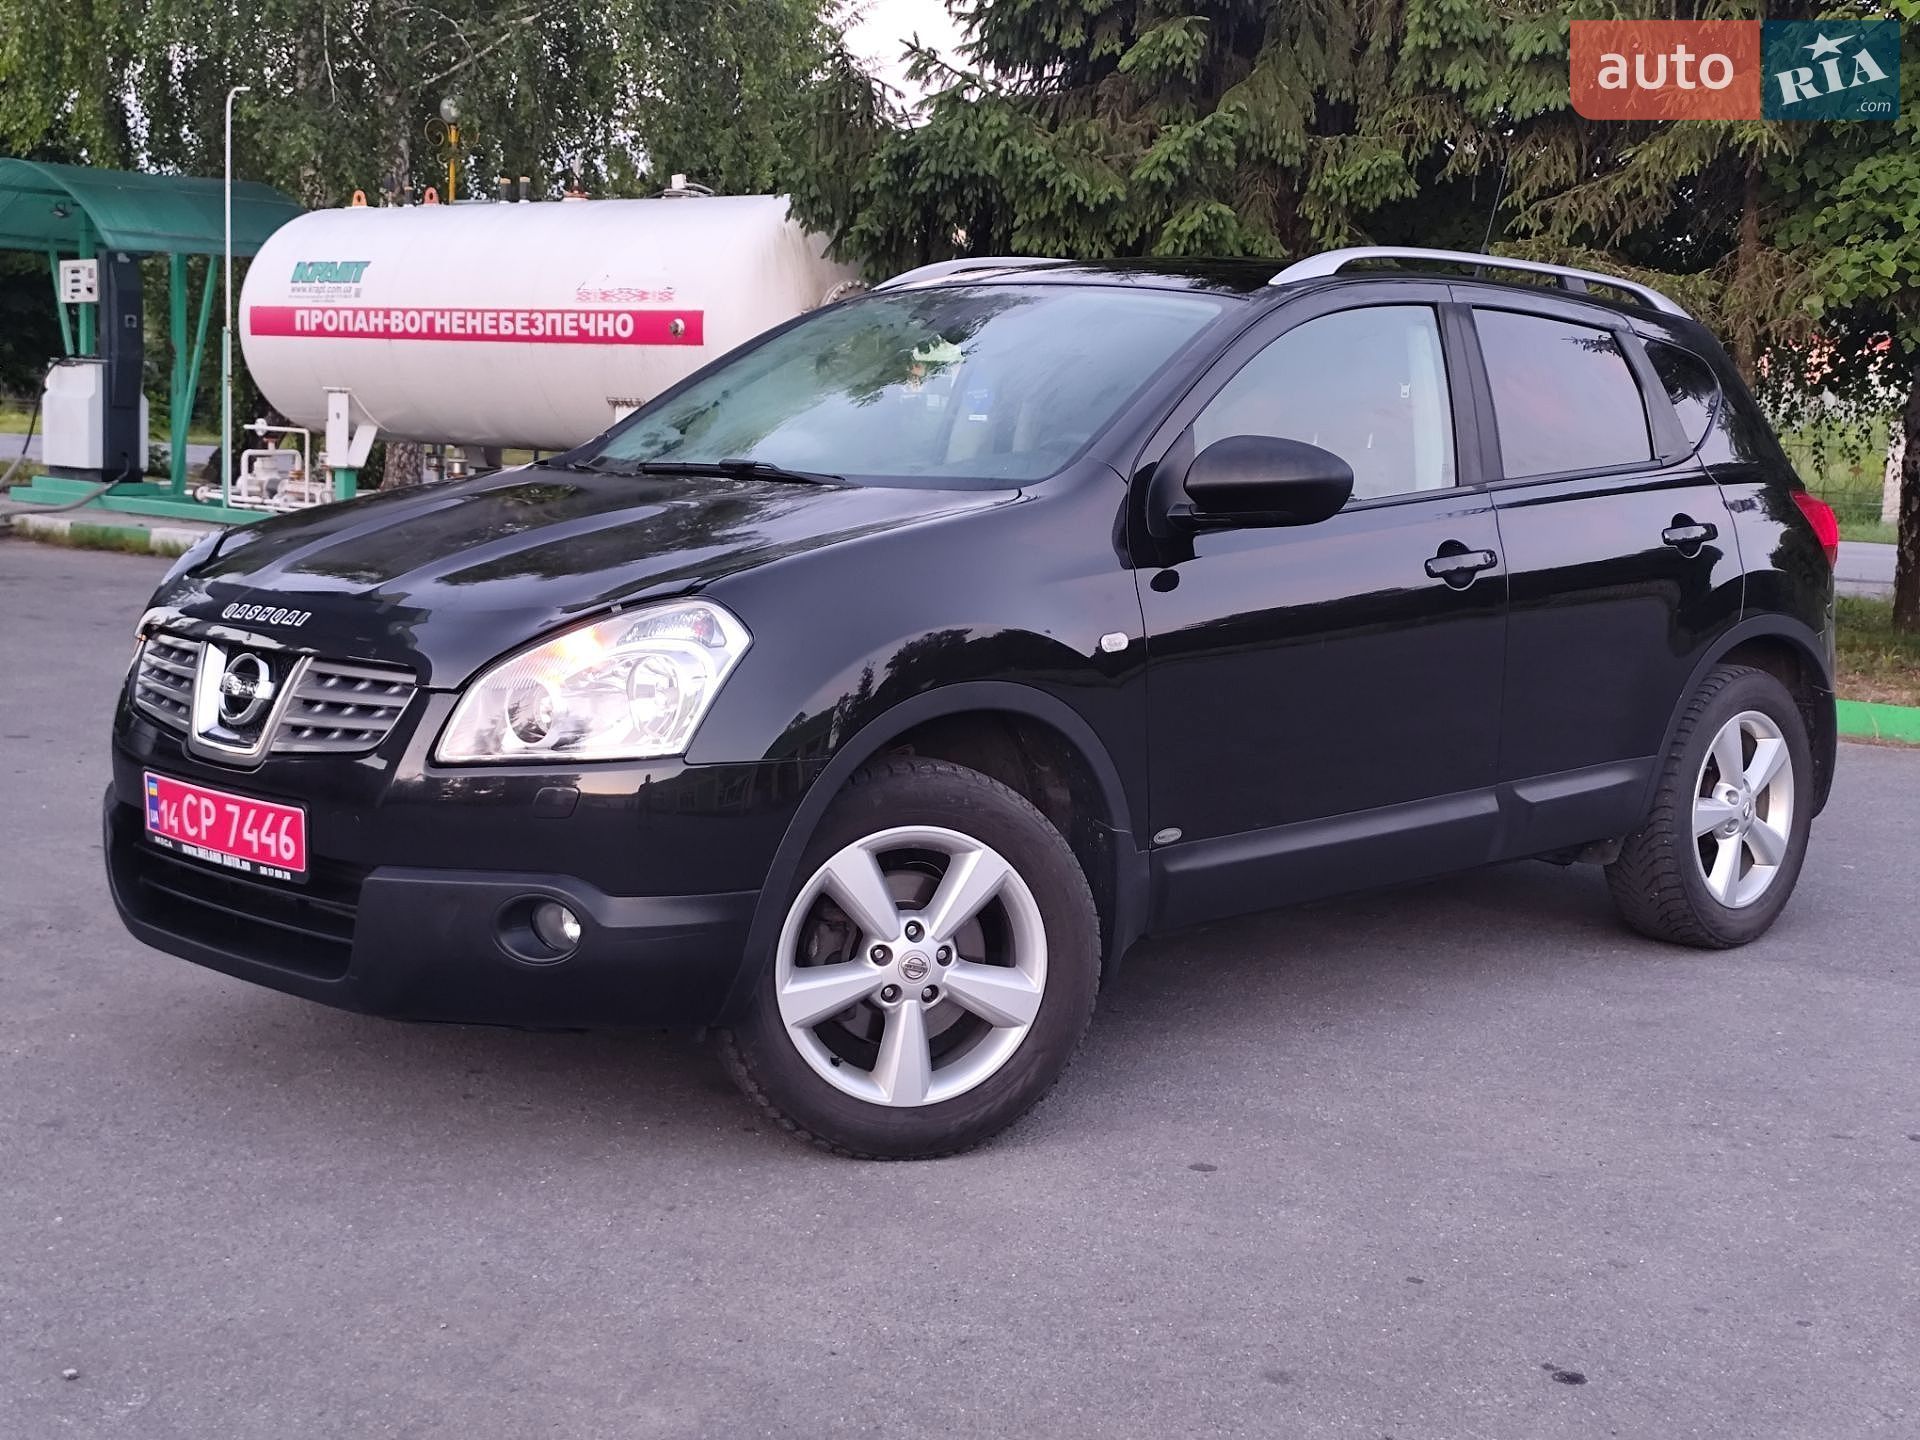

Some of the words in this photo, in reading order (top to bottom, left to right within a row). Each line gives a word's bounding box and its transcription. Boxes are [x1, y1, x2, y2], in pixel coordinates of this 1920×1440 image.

[295, 309, 634, 338] ПРОПАН-ВОГНЕНЕБЕЗПЕЧНО
[222, 603, 312, 627] QASHQAI
[225, 804, 296, 861] 7446
